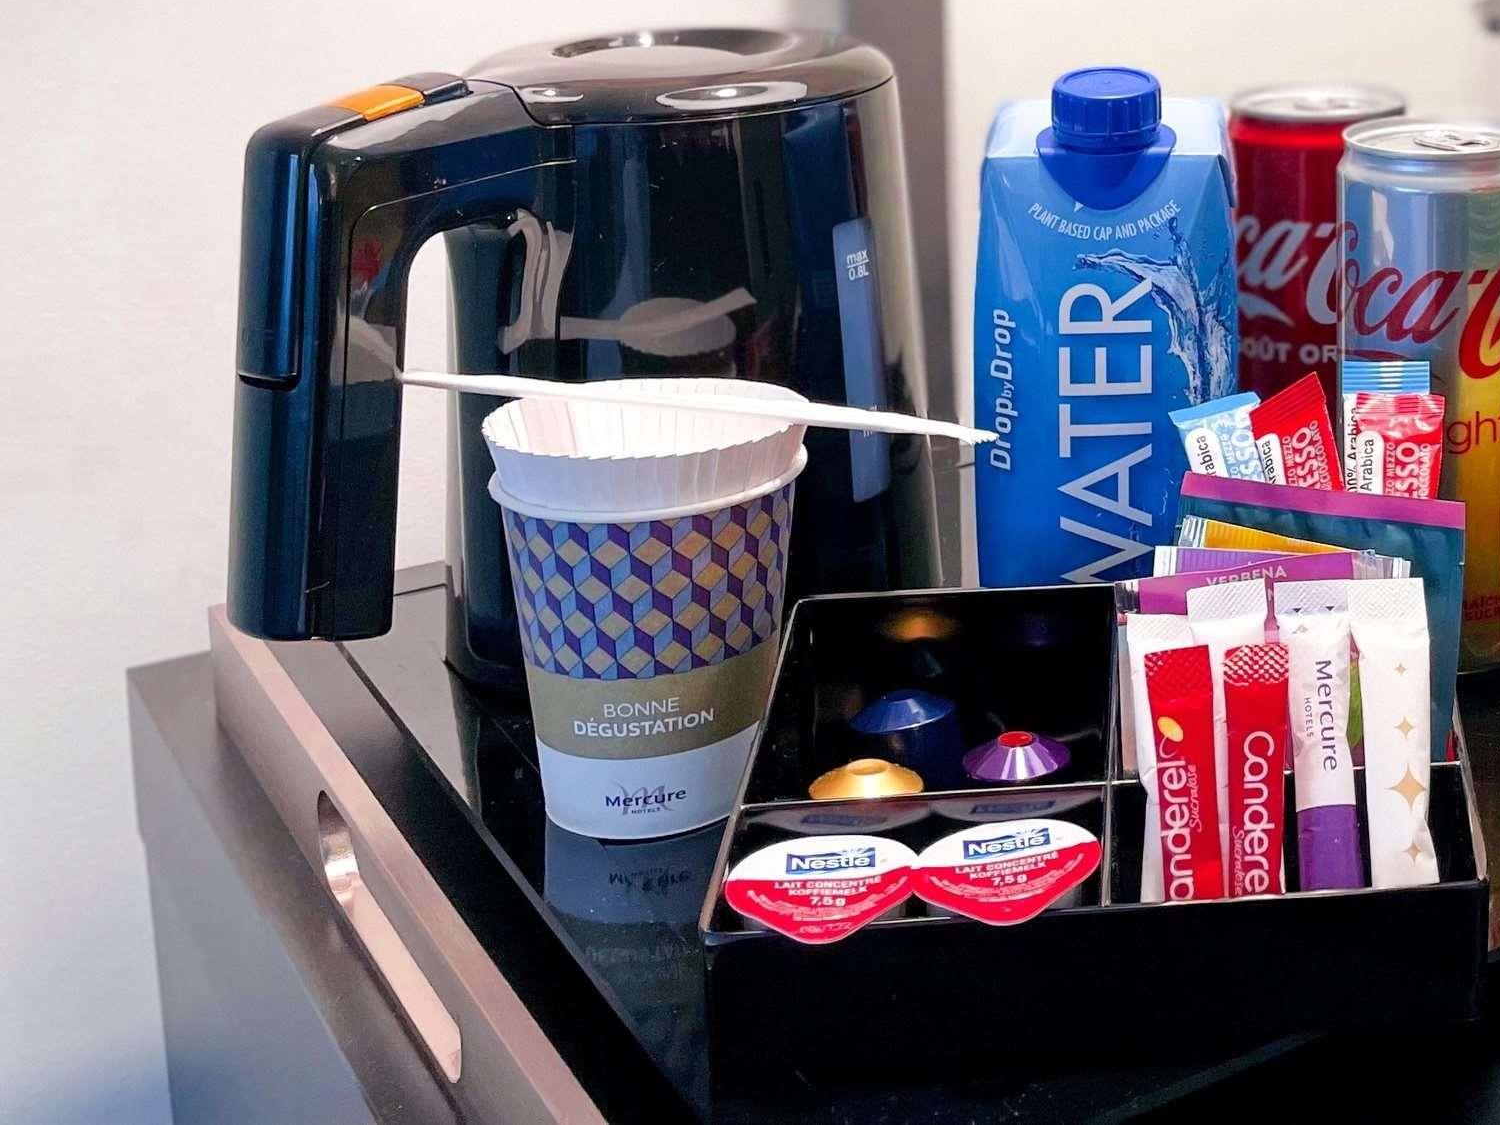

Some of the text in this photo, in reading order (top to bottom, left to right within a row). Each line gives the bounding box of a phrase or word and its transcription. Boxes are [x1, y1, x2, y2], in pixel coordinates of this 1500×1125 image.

[1028, 199, 1182, 241] PLANT BASED CAP AND PACKAGE
[846, 250, 869, 265] max
[848, 265, 870, 281] 0.8L
[1240, 335, 1292, 364] OÛT
[1196, 435, 1217, 476] rabica
[1282, 436, 1295, 467] MEZZO
[1360, 438, 1374, 492] Arabica
[1386, 442, 1396, 477] MEZZO
[603, 696, 681, 719] BONNE
[1304, 697, 1314, 738] HOTELS
[1315, 659, 1338, 771] Mercure
[573, 708, 715, 737] DÉGUSTATION
[605, 789, 688, 807] Mercure
[1243, 730, 1275, 894] Candere
[1157, 759, 1195, 900] anderel
[955, 850, 1060, 874] LAIT CONCENTRÉ
[969, 862, 1047, 880] KOFFIEMELK
[774, 881, 804, 890] LAIT
[787, 886, 869, 896] KOFFIEMELK
[1016, 874, 1028, 884] g
[835, 897, 847, 907] g
